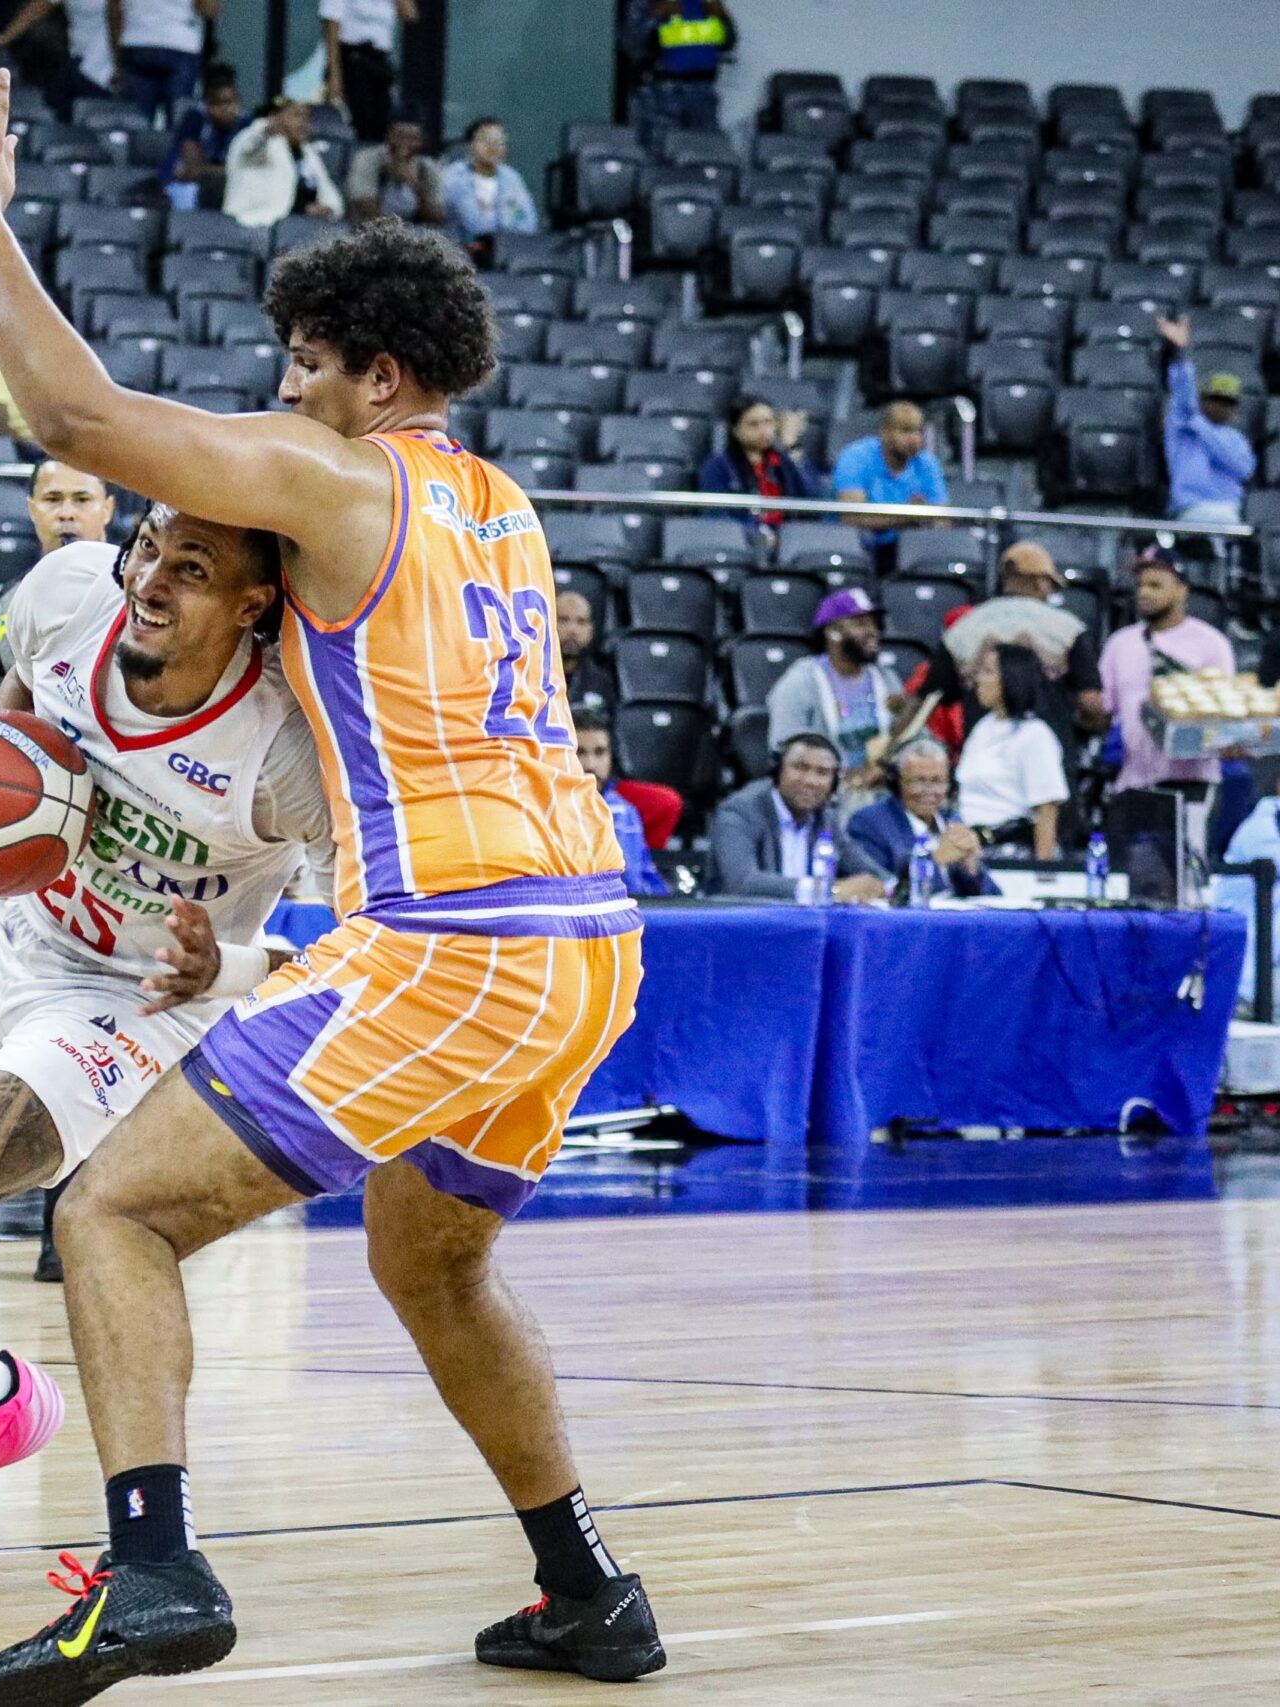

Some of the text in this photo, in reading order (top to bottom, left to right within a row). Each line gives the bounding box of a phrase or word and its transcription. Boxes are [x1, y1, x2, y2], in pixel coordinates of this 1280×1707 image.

[461, 580, 575, 749] 22
[168, 752, 231, 797] GBC
[90, 1055, 124, 1087] JS
